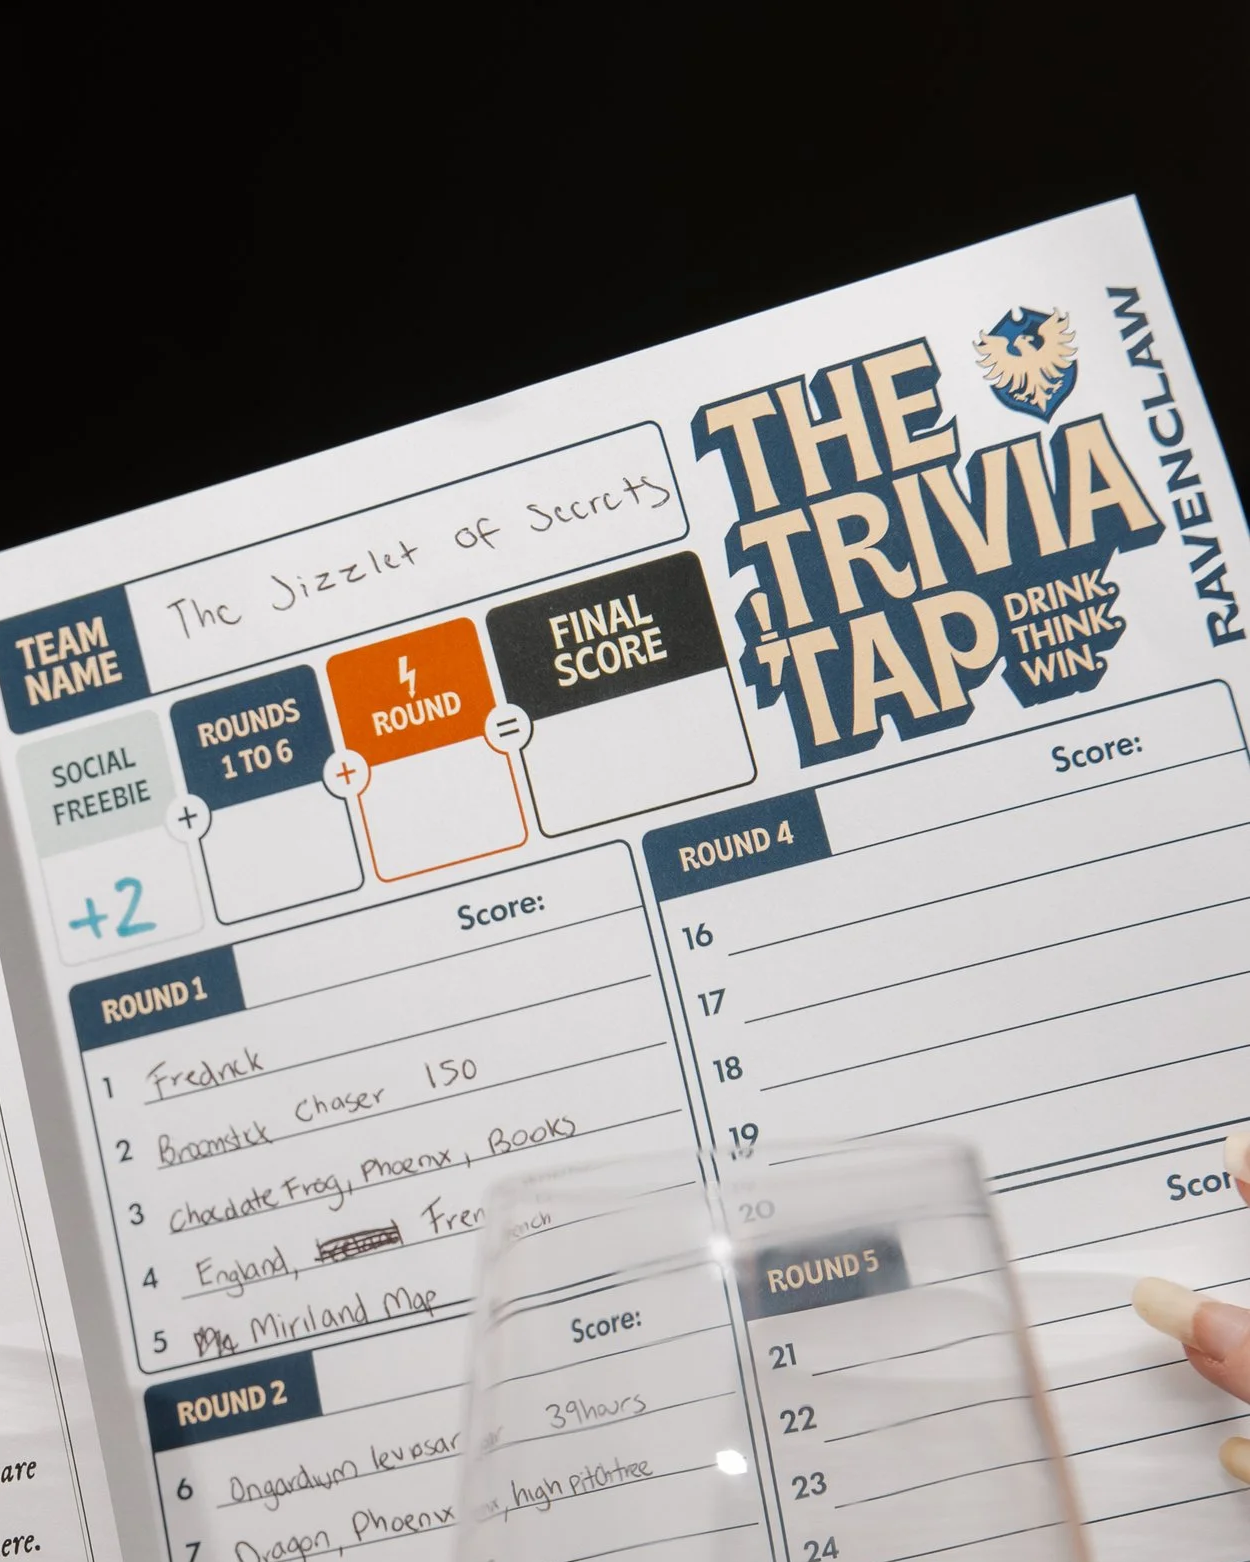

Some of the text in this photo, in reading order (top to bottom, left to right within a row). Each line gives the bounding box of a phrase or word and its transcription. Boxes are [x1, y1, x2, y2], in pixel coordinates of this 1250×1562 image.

[706, 340, 956, 512] THE
[1107, 286, 1248, 648] RAVENCLAW
[740, 414, 1159, 629] TRIVIA
[1004, 571, 1118, 622] DRINK.
[549, 594, 655, 649] FINAL
[1011, 601, 1123, 655] THINK.
[16, 616, 108, 669] TEAM
[553, 629, 668, 686] SCORE
[24, 656, 122, 706] NAME
[773, 591, 1000, 747] TAP
[1019, 649, 1105, 688] WIN.
[197, 698, 300, 748] ROUNDS
[372, 691, 462, 736] ROUND
[51, 747, 137, 789] SOCIAL
[1051, 736, 1143, 773] Score:
[52, 779, 151, 826] FREEBIE
[679, 828, 770, 873] ROUND
[457, 895, 545, 931] Score:
[681, 922, 714, 951] 16
[102, 979, 187, 1024] ROUND
[697, 987, 726, 1017] 17
[712, 1055, 744, 1084] 18
[295, 1058, 477, 1123] Chaser 150
[115, 1139, 133, 1163] 2
[488, 1116, 577, 1155] Books
[128, 1202, 145, 1226] 3
[142, 1267, 159, 1289] 4
[768, 1253, 860, 1293] ROUND
[383, 1287, 436, 1316] Map
[153, 1330, 168, 1354] 5
[571, 1311, 642, 1344] Score:
[768, 1342, 797, 1371] 21
[177, 1385, 266, 1427] ROUND
[779, 1405, 818, 1435] 22
[176, 1477, 194, 1501] 6
[791, 1471, 828, 1501] 23
